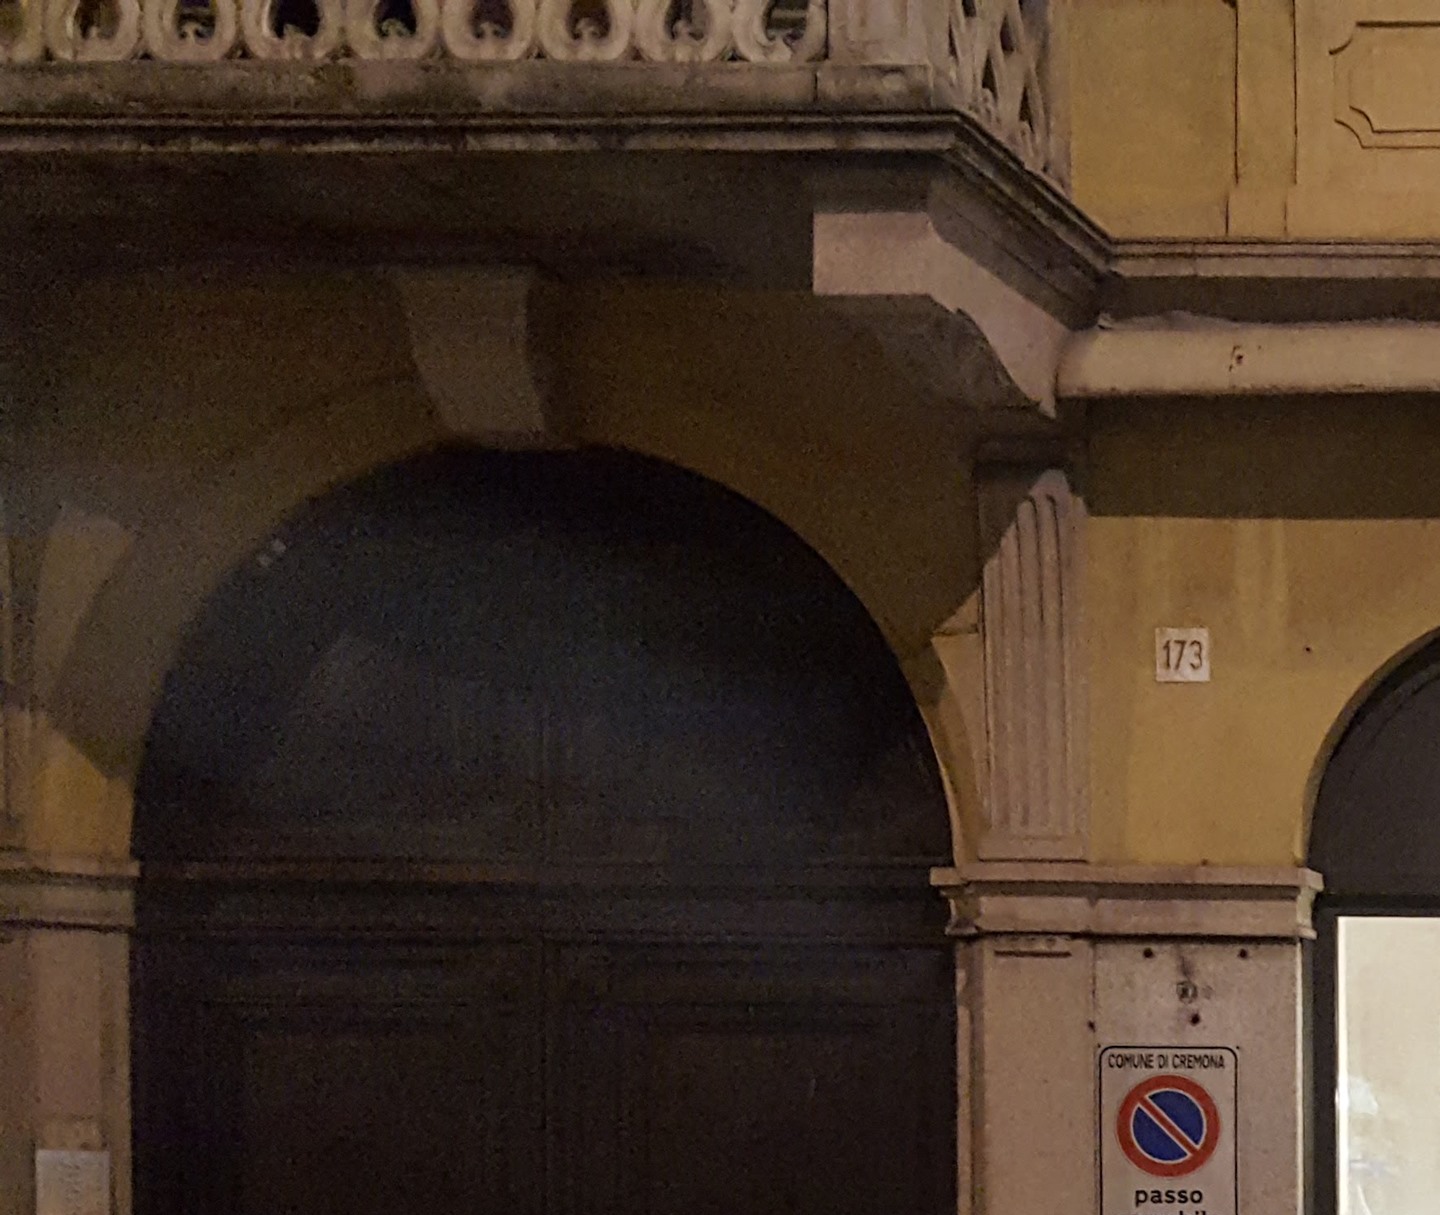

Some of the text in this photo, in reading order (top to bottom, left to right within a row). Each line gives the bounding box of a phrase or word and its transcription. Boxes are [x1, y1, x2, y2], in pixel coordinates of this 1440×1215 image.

[1162, 639, 1203, 671] 173
[1108, 1054, 1225, 1069] COMUNE DI CREMONA
[1135, 1189, 1203, 1208] passo
